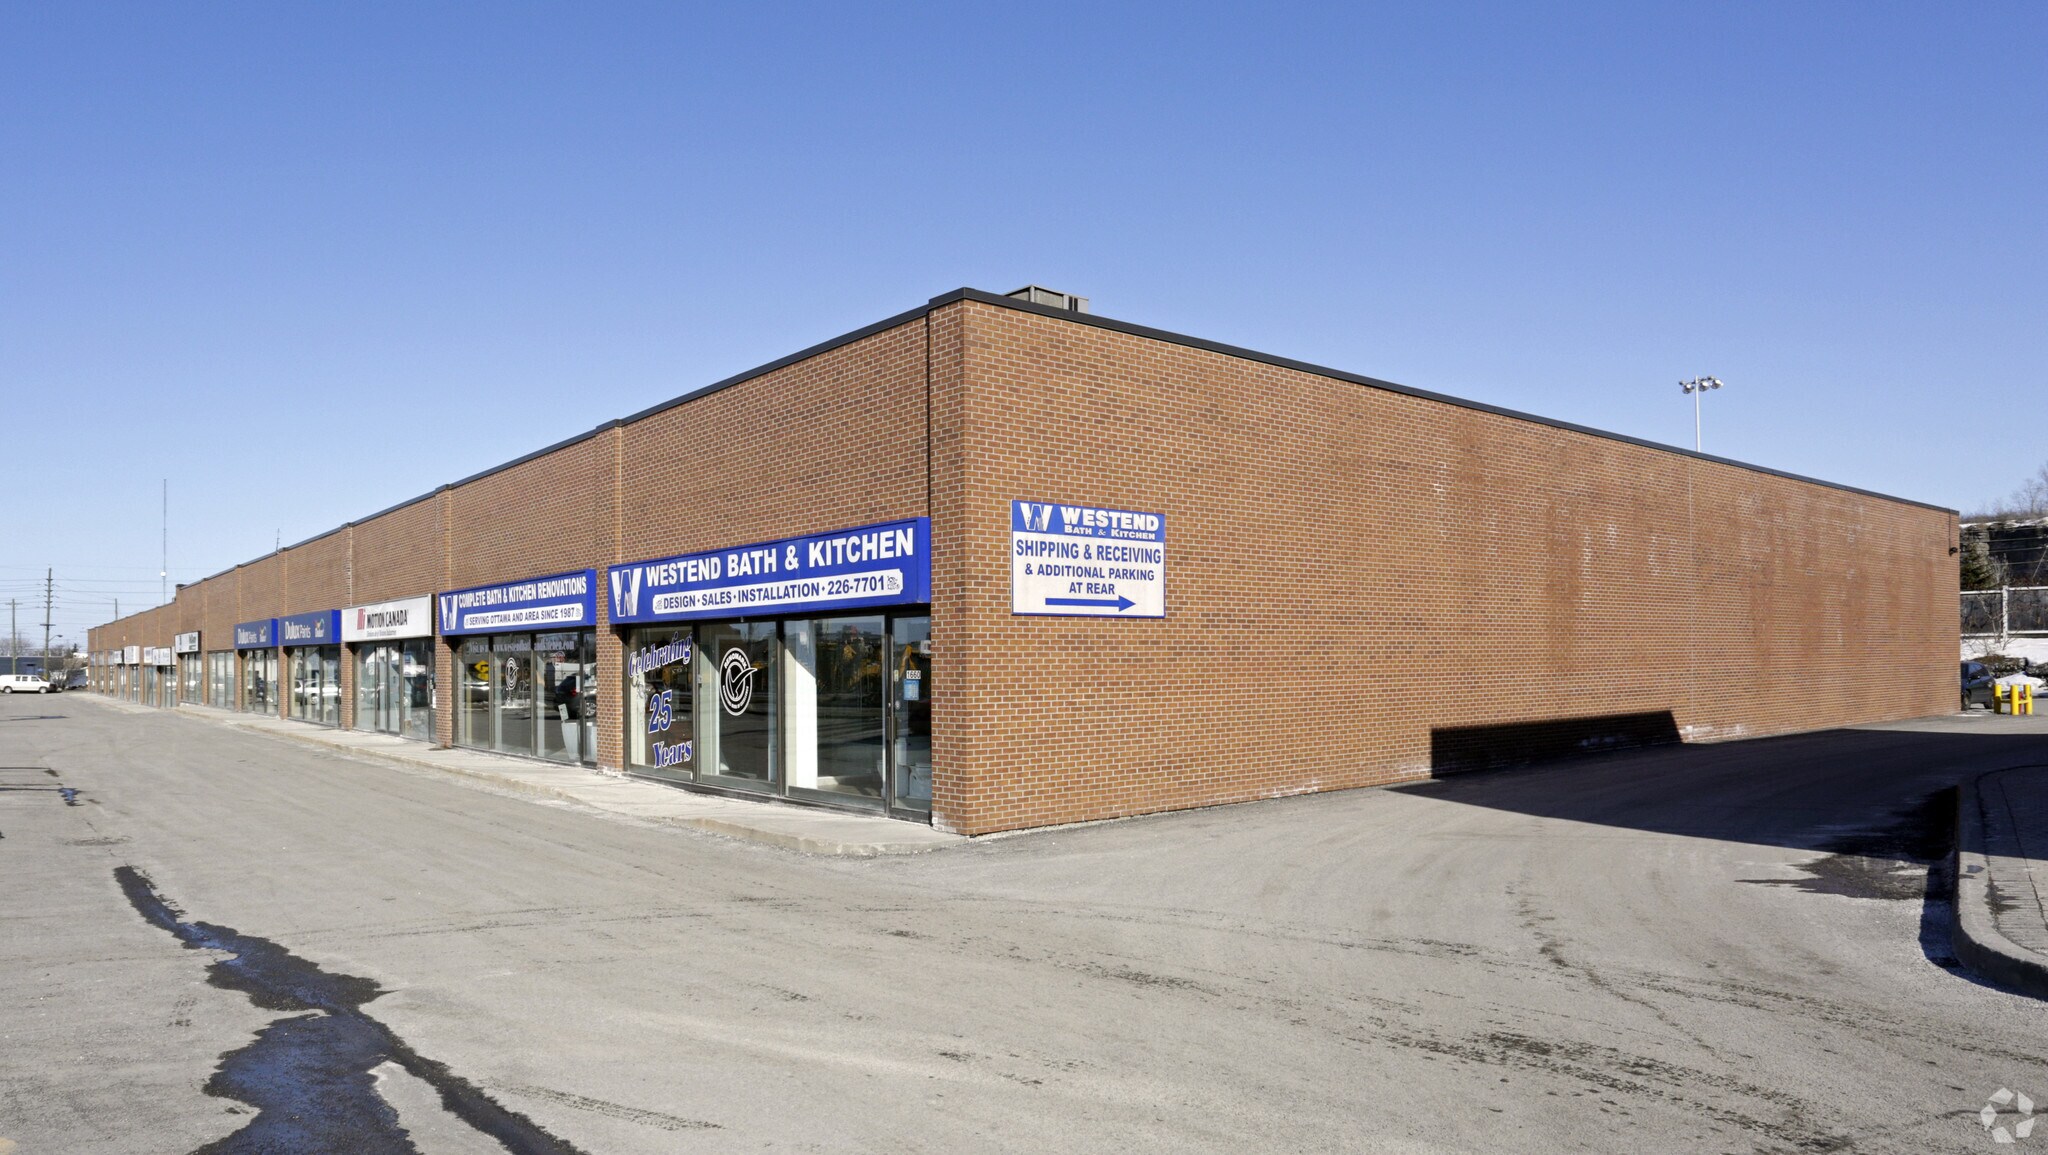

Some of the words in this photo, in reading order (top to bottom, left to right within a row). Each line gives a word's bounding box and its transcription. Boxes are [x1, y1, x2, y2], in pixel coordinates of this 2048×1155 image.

[1060, 506, 1159, 532] WESTEND
[646, 556, 721, 587] WESTEND
[728, 548, 777, 577] BATH
[784, 544, 799, 570] &
[808, 527, 914, 568] KITCHEN
[1016, 539, 1079, 560] SHIPPING
[1083, 544, 1092, 560] &
[1097, 545, 1161, 564] RECEIVING
[1025, 563, 1033, 575] &
[1037, 564, 1105, 579] ADDITIONAL
[1109, 568, 1155, 581] PARKING
[459, 591, 486, 608] COMPLETE
[487, 588, 501, 604] BATH
[503, 588, 508, 603] &
[509, 584, 536, 602] KITCHEN
[538, 576, 587, 599] RENOVATIONS
[663, 595, 696, 610] DESIGN
[702, 591, 732, 606] SALES
[738, 582, 820, 603] INSTALLATION
[827, 575, 885, 595] 226-7701
[1069, 582, 1083, 594] AT
[1086, 582, 1115, 595] REAR
[386, 609, 408, 627] CANADA
[469, 615, 489, 626] SERVING
[490, 613, 511, 623] OTTAWA
[512, 612, 524, 622] AND
[525, 611, 539, 620] AREA
[541, 609, 558, 619] SINCE
[560, 607, 575, 618] 1987
[628, 631, 692, 678] Celebrating
[648, 689, 672, 734] 25
[653, 740, 692, 768] Years
